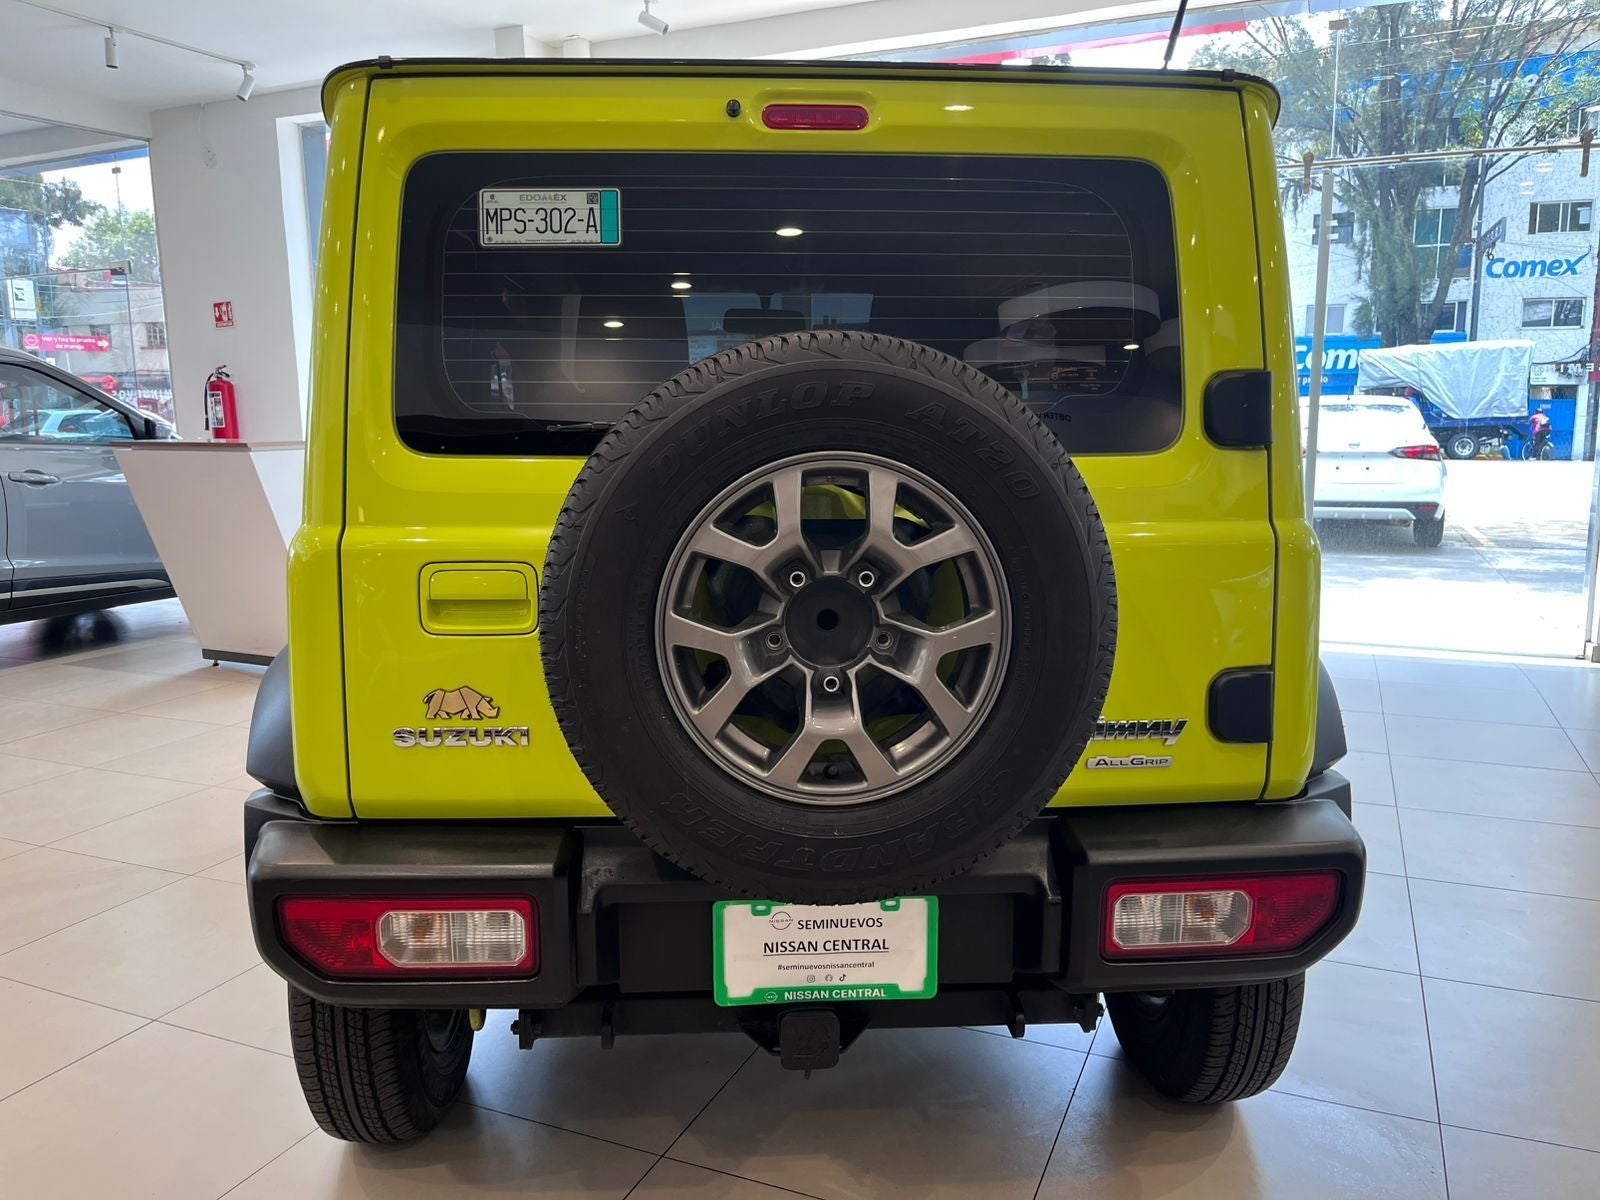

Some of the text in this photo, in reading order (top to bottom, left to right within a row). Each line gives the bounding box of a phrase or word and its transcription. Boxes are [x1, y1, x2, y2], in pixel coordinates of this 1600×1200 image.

[485, 207, 599, 235] MPS-302-A
[1486, 250, 1589, 278] Comex
[1296, 345, 1358, 370] Com
[649, 380, 1042, 501] DUNLOP AT20
[393, 726, 529, 748] SUZUKI
[1089, 716, 1188, 745] imny
[797, 917, 883, 930] SEMINUEVOS
[763, 938, 889, 954] NISSAN CENTRAL
[777, 961, 875, 971] #seminuevosnissancentral
[784, 990, 829, 1000] NISSAN
[832, 989, 886, 999] CENTRAL
